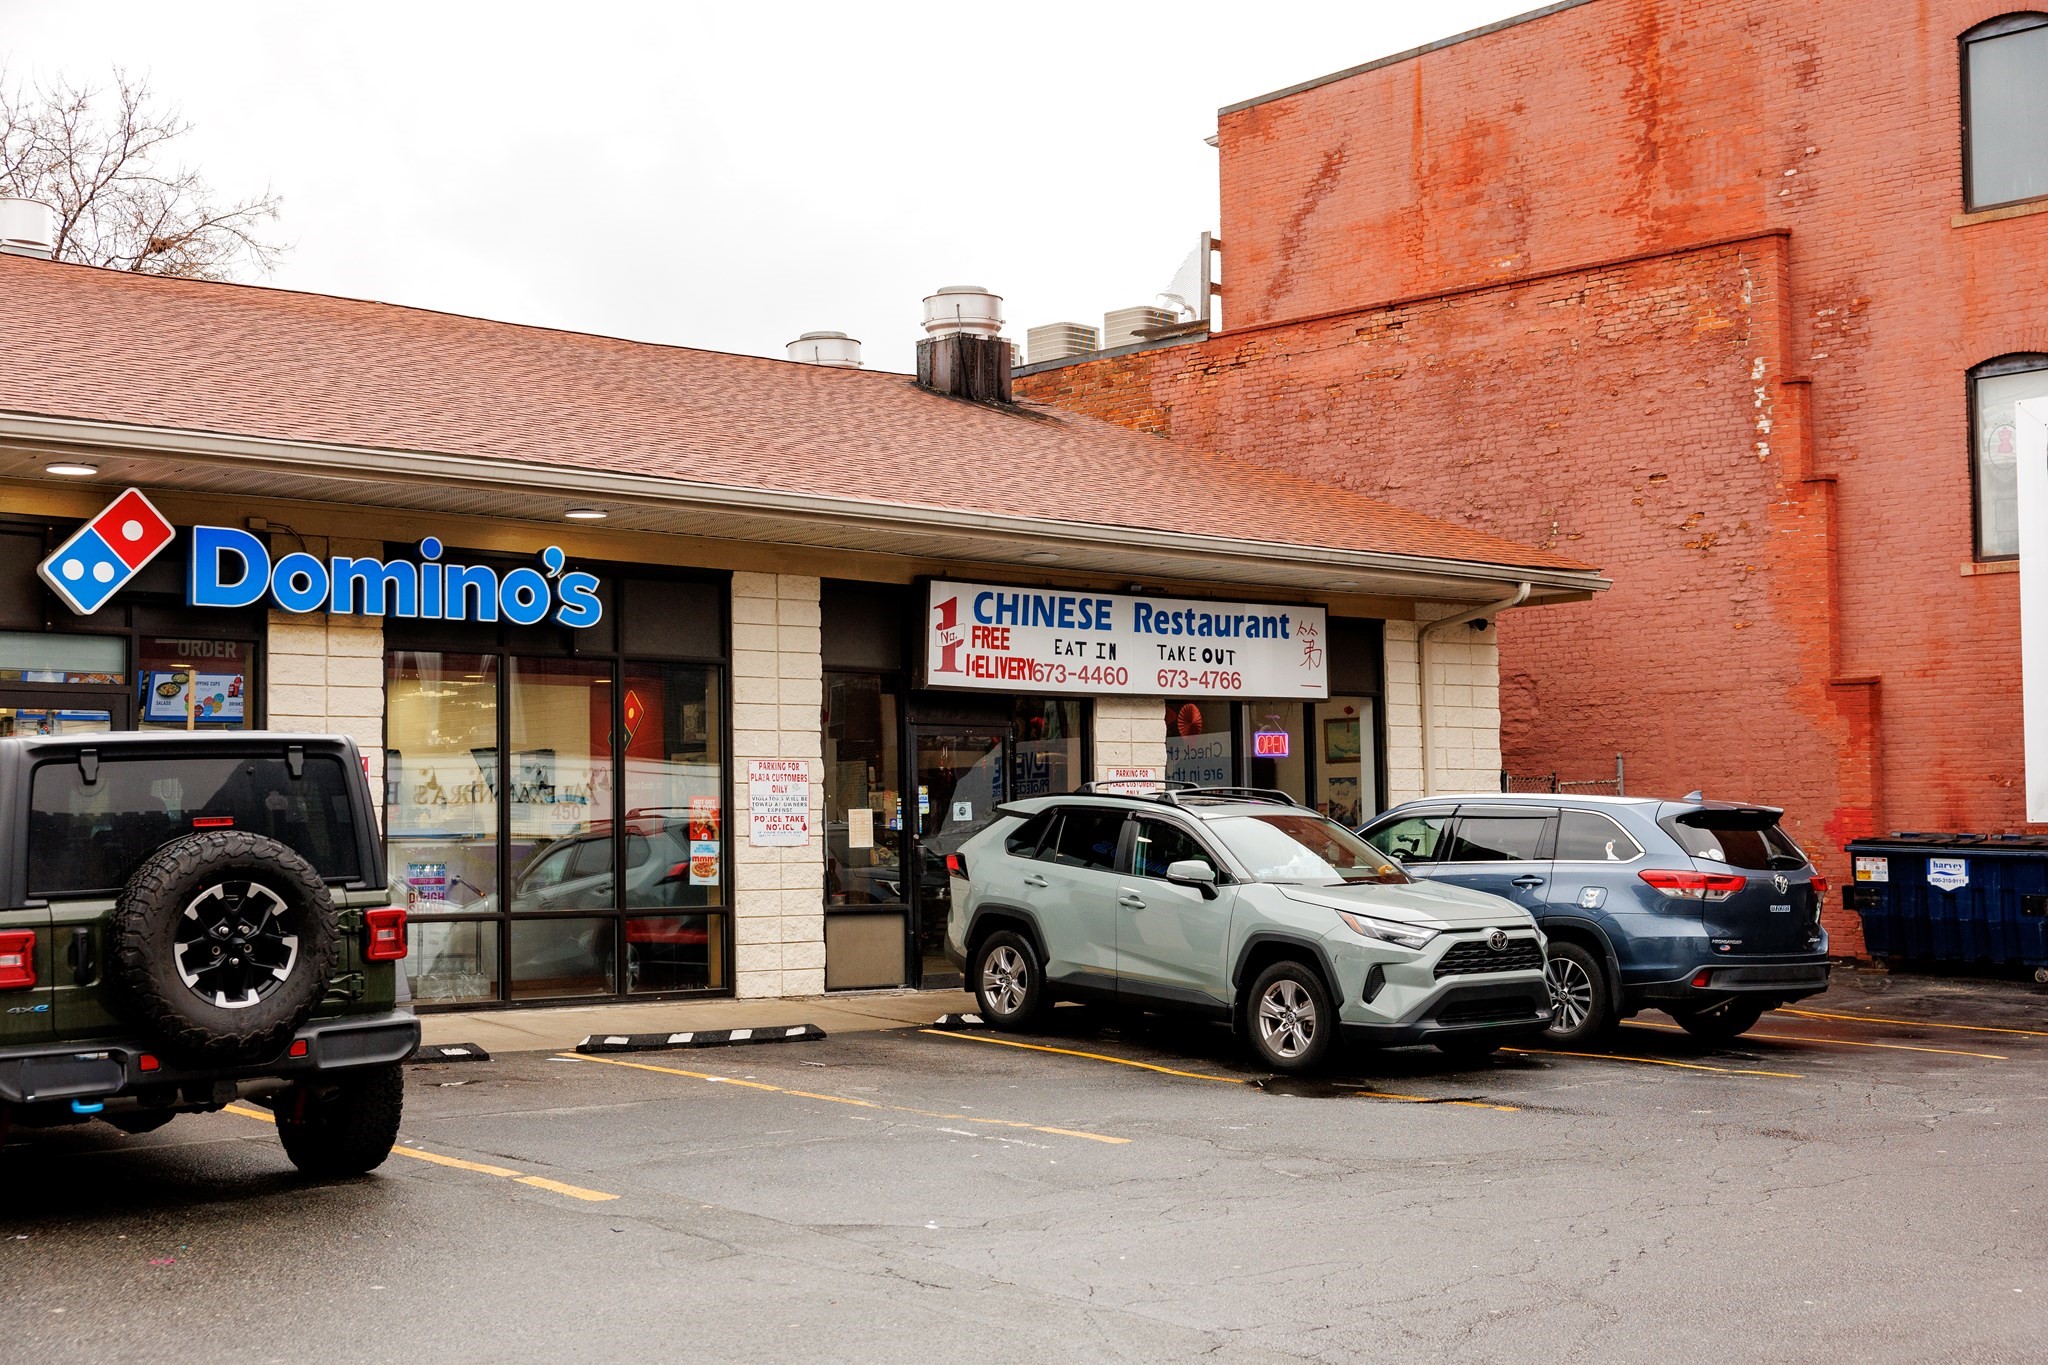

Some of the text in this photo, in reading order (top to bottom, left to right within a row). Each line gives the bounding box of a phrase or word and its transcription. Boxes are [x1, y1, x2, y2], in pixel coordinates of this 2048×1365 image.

[188, 525, 603, 628] Domino's
[974, 591, 1290, 640] CHINESE Restaurant
[941, 631, 958, 644] No.
[972, 625, 1010, 650] FREE
[178, 641, 237, 658] ORDER
[1054, 639, 1116, 660] EAT IN
[1157, 644, 1236, 666] TAKE OUT
[1032, 662, 1129, 686] 673-4460
[1157, 669, 1242, 690] 673-4766
[1257, 735, 1287, 754] OPEN
[759, 762, 800, 771] PARKING FOR
[772, 774, 807, 782] CUSTOMERS
[771, 785, 788, 793] ONLY
[1933, 861, 1963, 870] harvey
